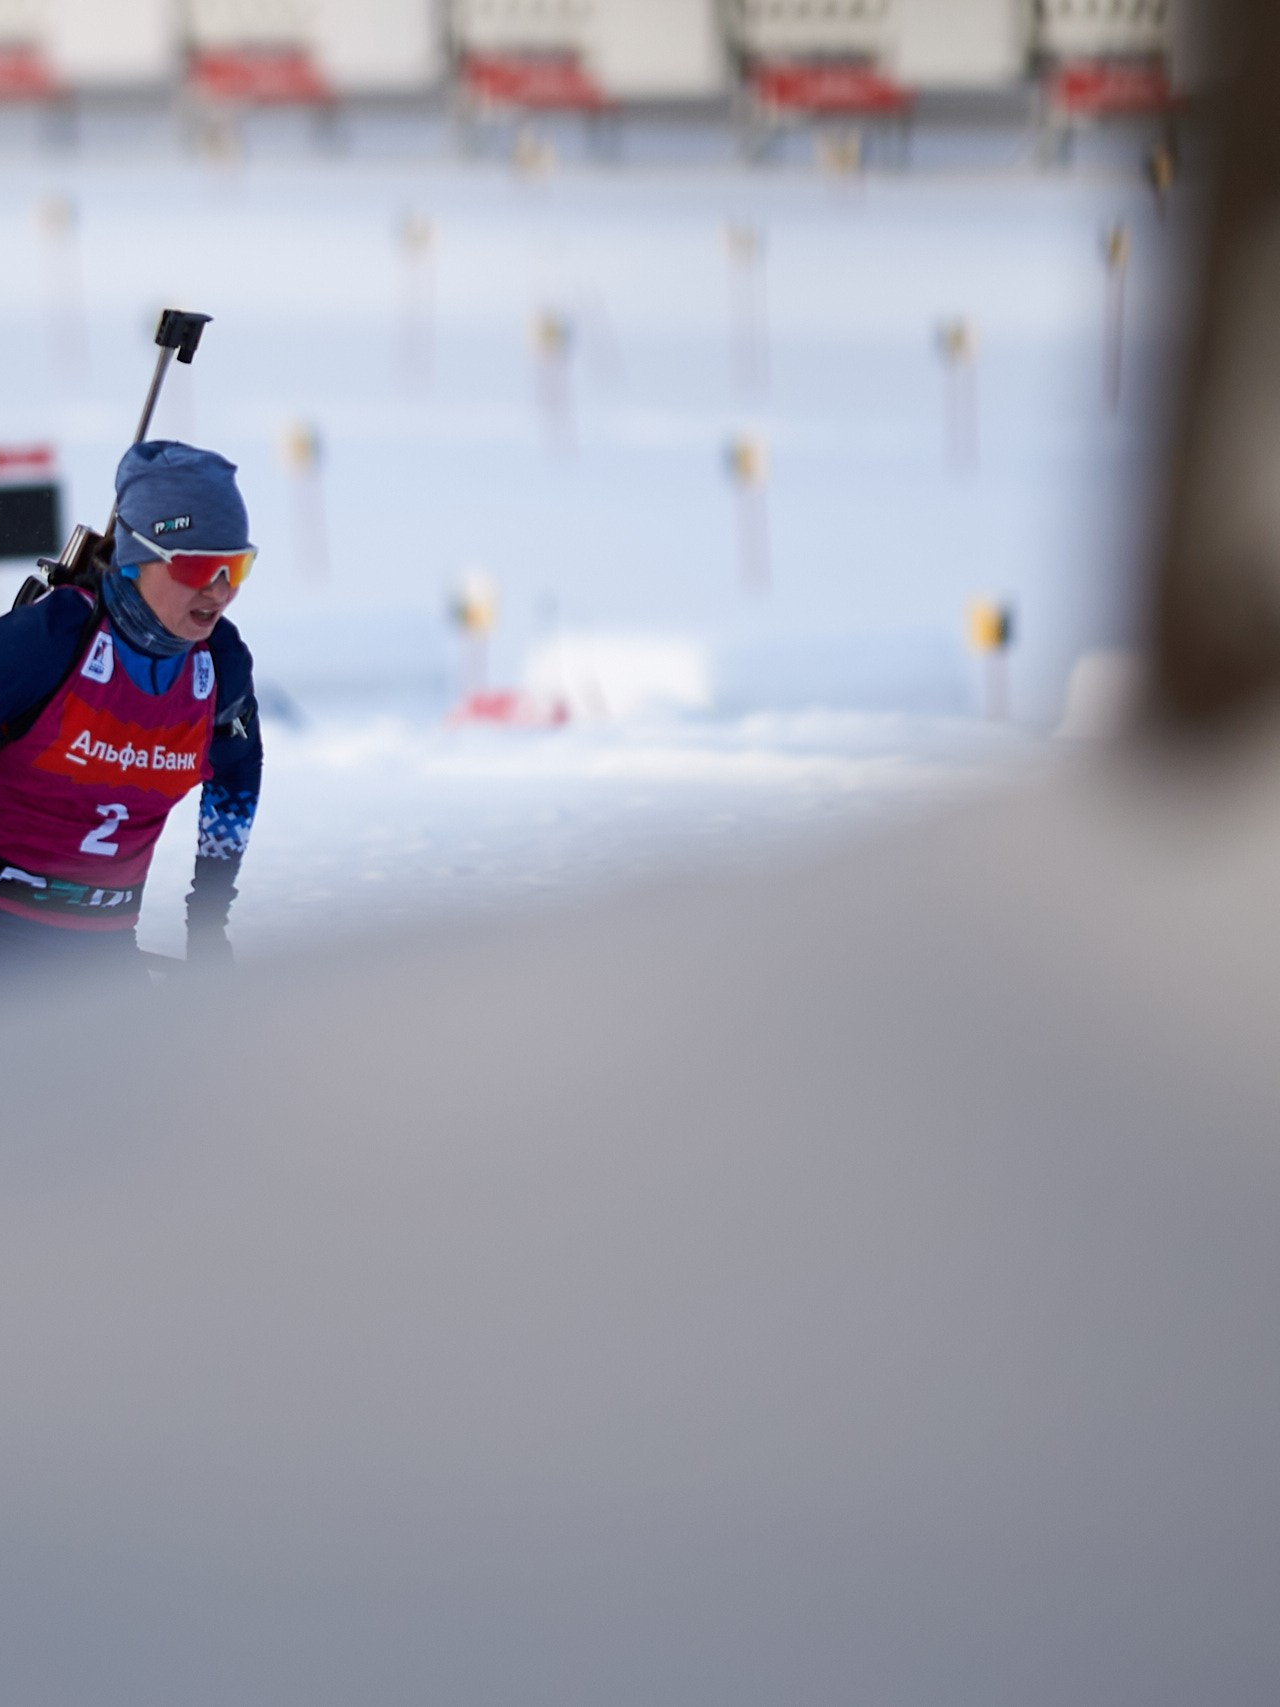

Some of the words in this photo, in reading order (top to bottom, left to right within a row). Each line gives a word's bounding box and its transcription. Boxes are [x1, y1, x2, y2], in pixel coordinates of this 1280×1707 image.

[70, 729, 149, 771] Альфа
[152, 745, 197, 770] Банк
[80, 803, 130, 857] 2
